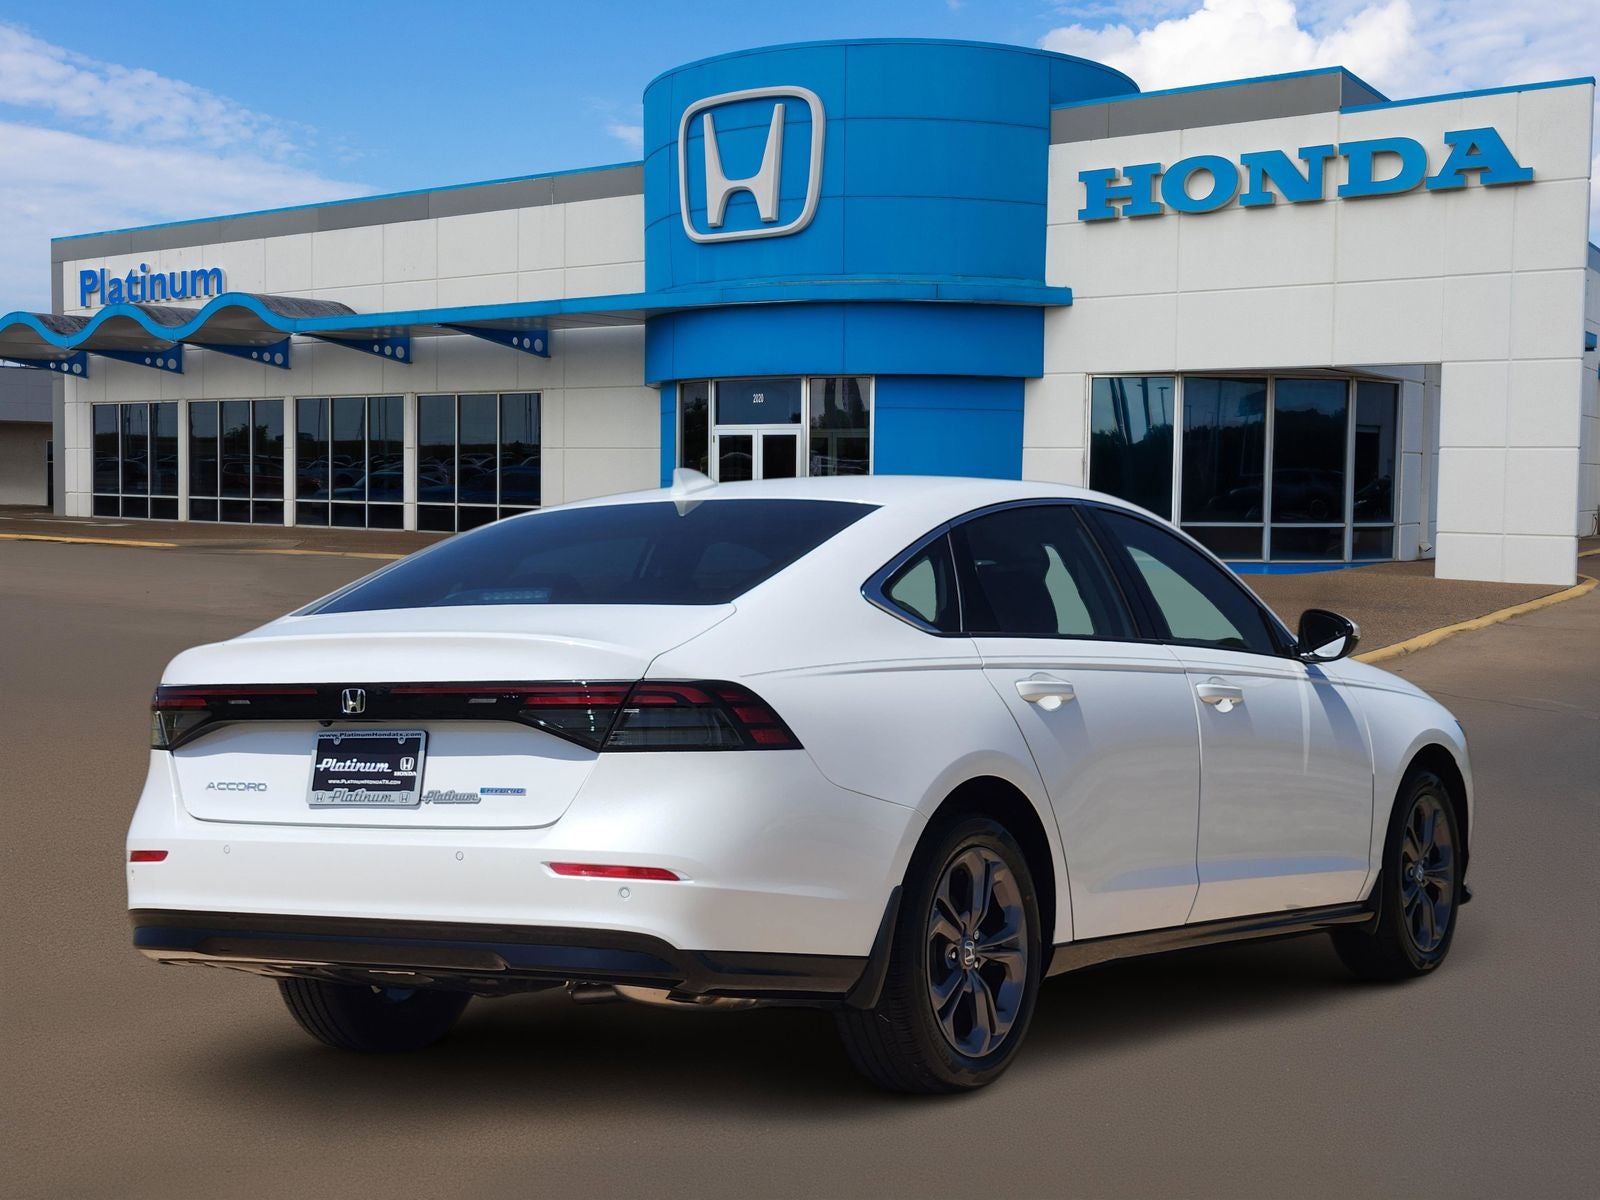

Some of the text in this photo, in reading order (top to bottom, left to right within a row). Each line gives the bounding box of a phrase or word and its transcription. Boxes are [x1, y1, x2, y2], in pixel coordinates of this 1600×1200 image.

[1078, 126, 1535, 221] HONDA
[80, 263, 224, 307] Platinum
[752, 393, 765, 404] 2020
[316, 758, 392, 772] Platinum
[206, 782, 268, 791] ACCORD
[328, 788, 395, 803] Platinum
[421, 790, 481, 804] Platinum
